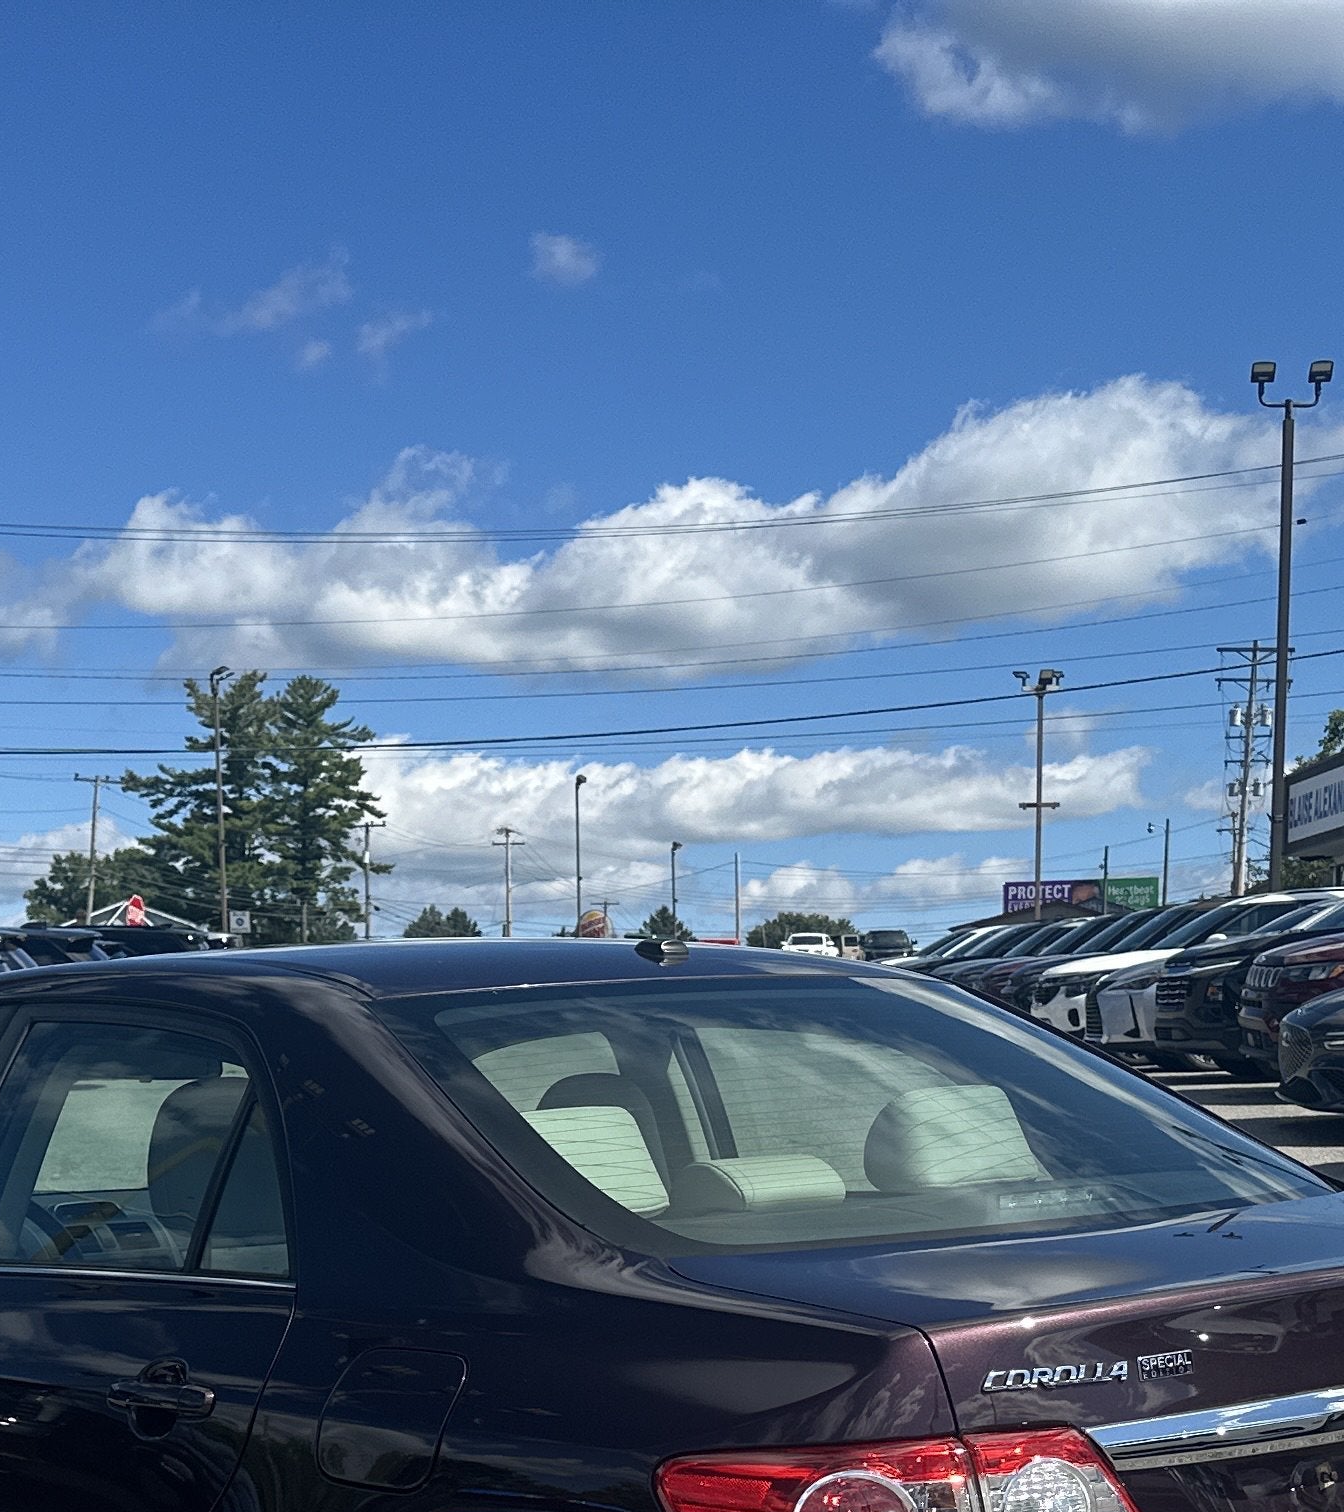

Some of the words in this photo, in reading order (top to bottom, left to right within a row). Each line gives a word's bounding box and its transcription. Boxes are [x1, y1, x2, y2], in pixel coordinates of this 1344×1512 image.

[1288, 791, 1313, 829] BLAISE
[1007, 884, 1072, 900] PROTECT
[1142, 1352, 1192, 1371] SPECIAL
[981, 1360, 1129, 1392] COROLLA
